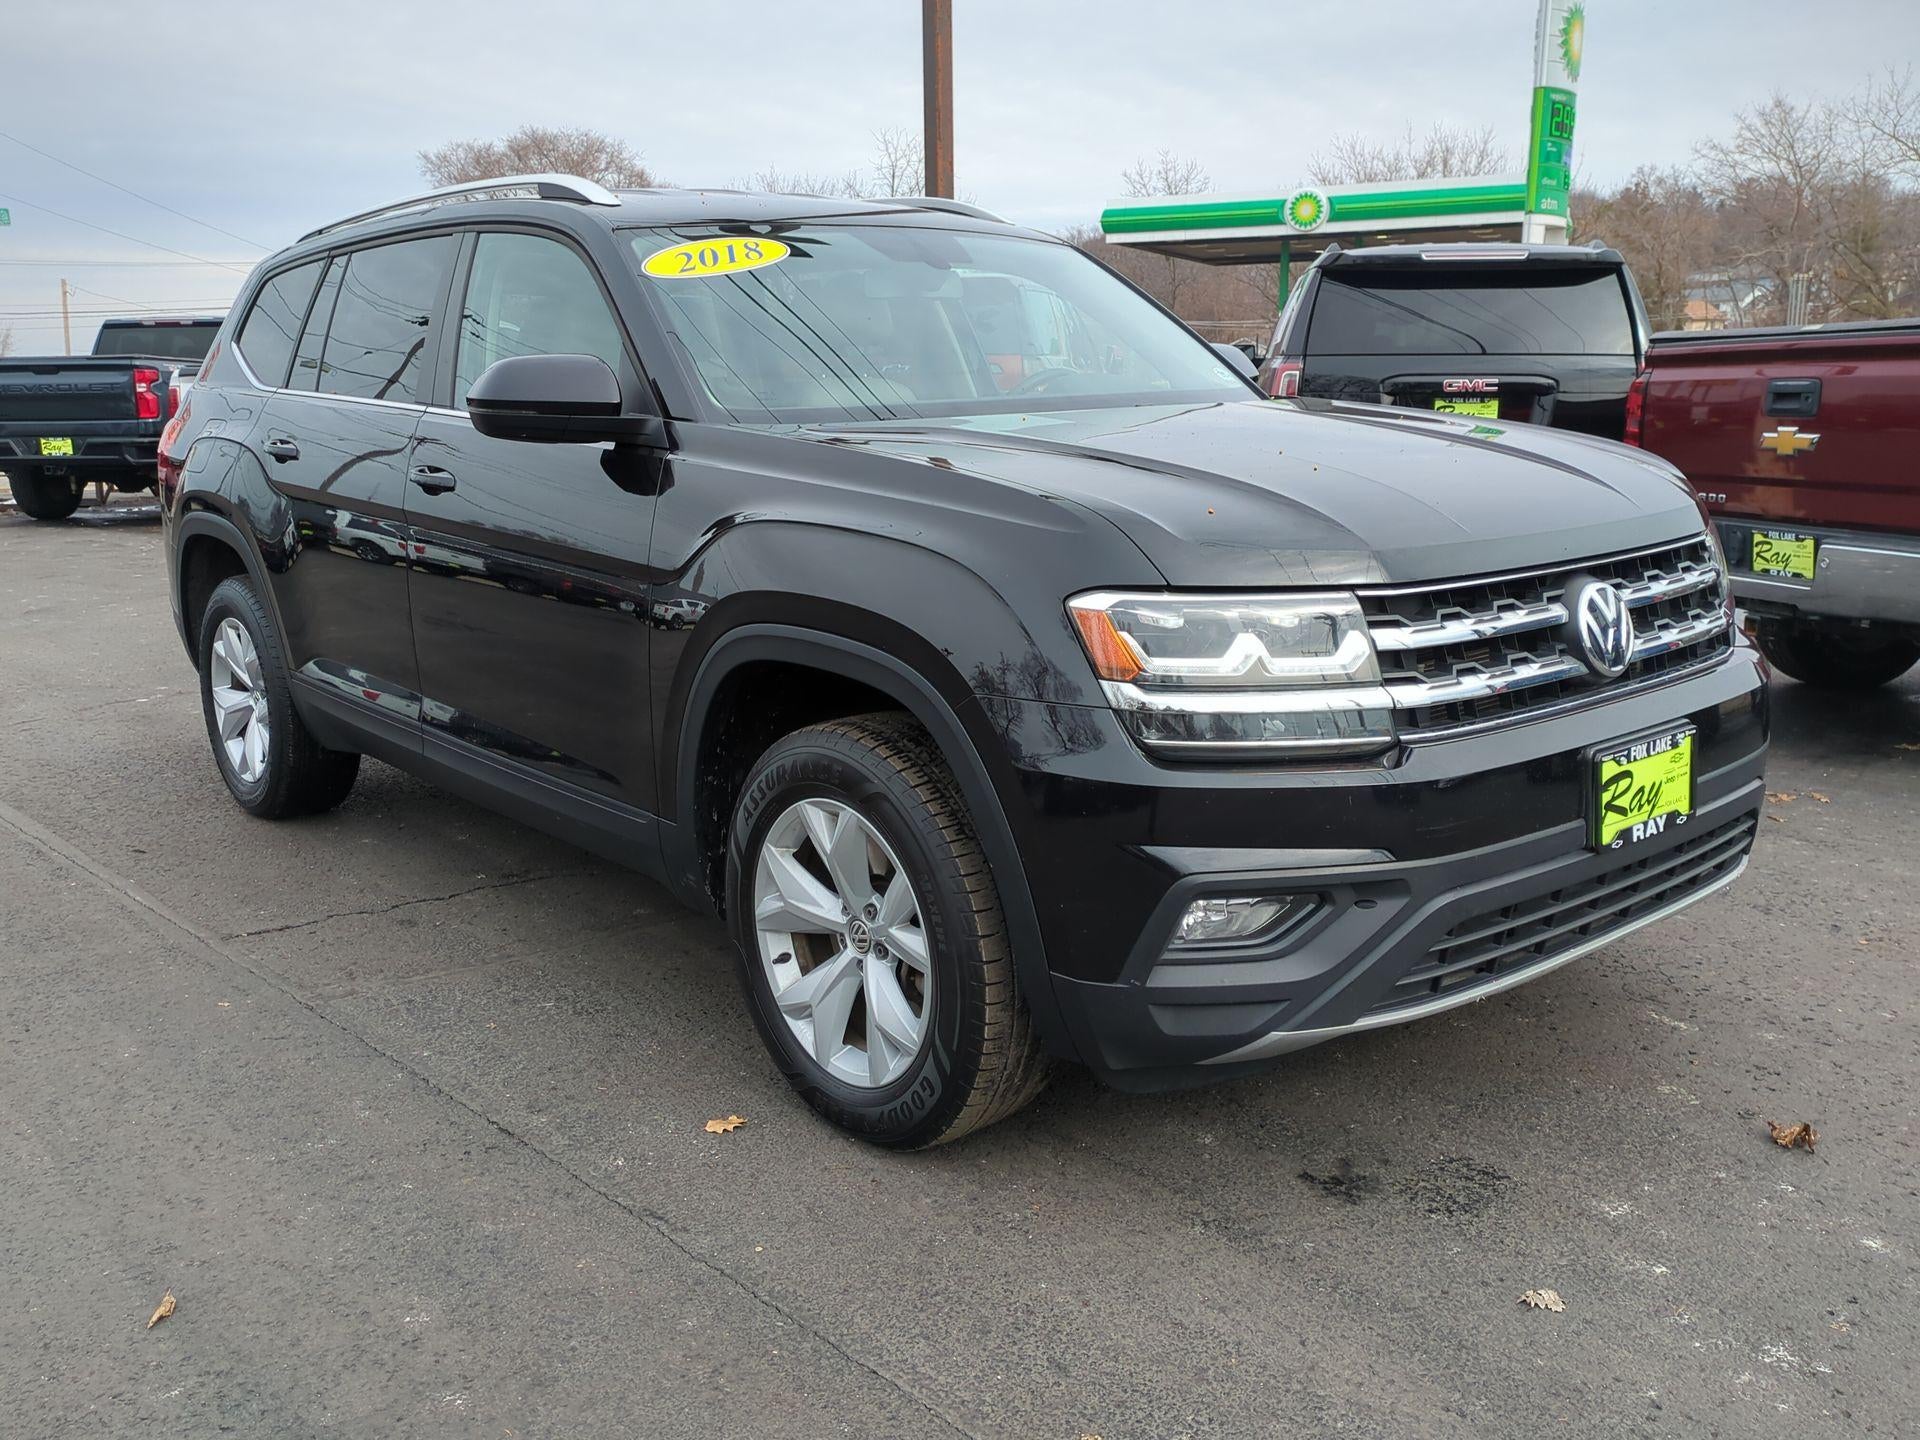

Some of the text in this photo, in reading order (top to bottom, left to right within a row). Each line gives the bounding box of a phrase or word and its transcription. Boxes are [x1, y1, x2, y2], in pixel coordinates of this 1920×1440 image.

[674, 241, 764, 274] 2018
[1443, 378, 1499, 392] GMC
[1768, 530, 1779, 539] FOX
[1781, 532, 1796, 541] LAKE
[1755, 540, 1792, 570] Ray
[1630, 743, 1648, 762] FOX
[1650, 735, 1672, 754] LAKE
[1601, 769, 1663, 824] Ray
[1632, 814, 1667, 842] RAY
